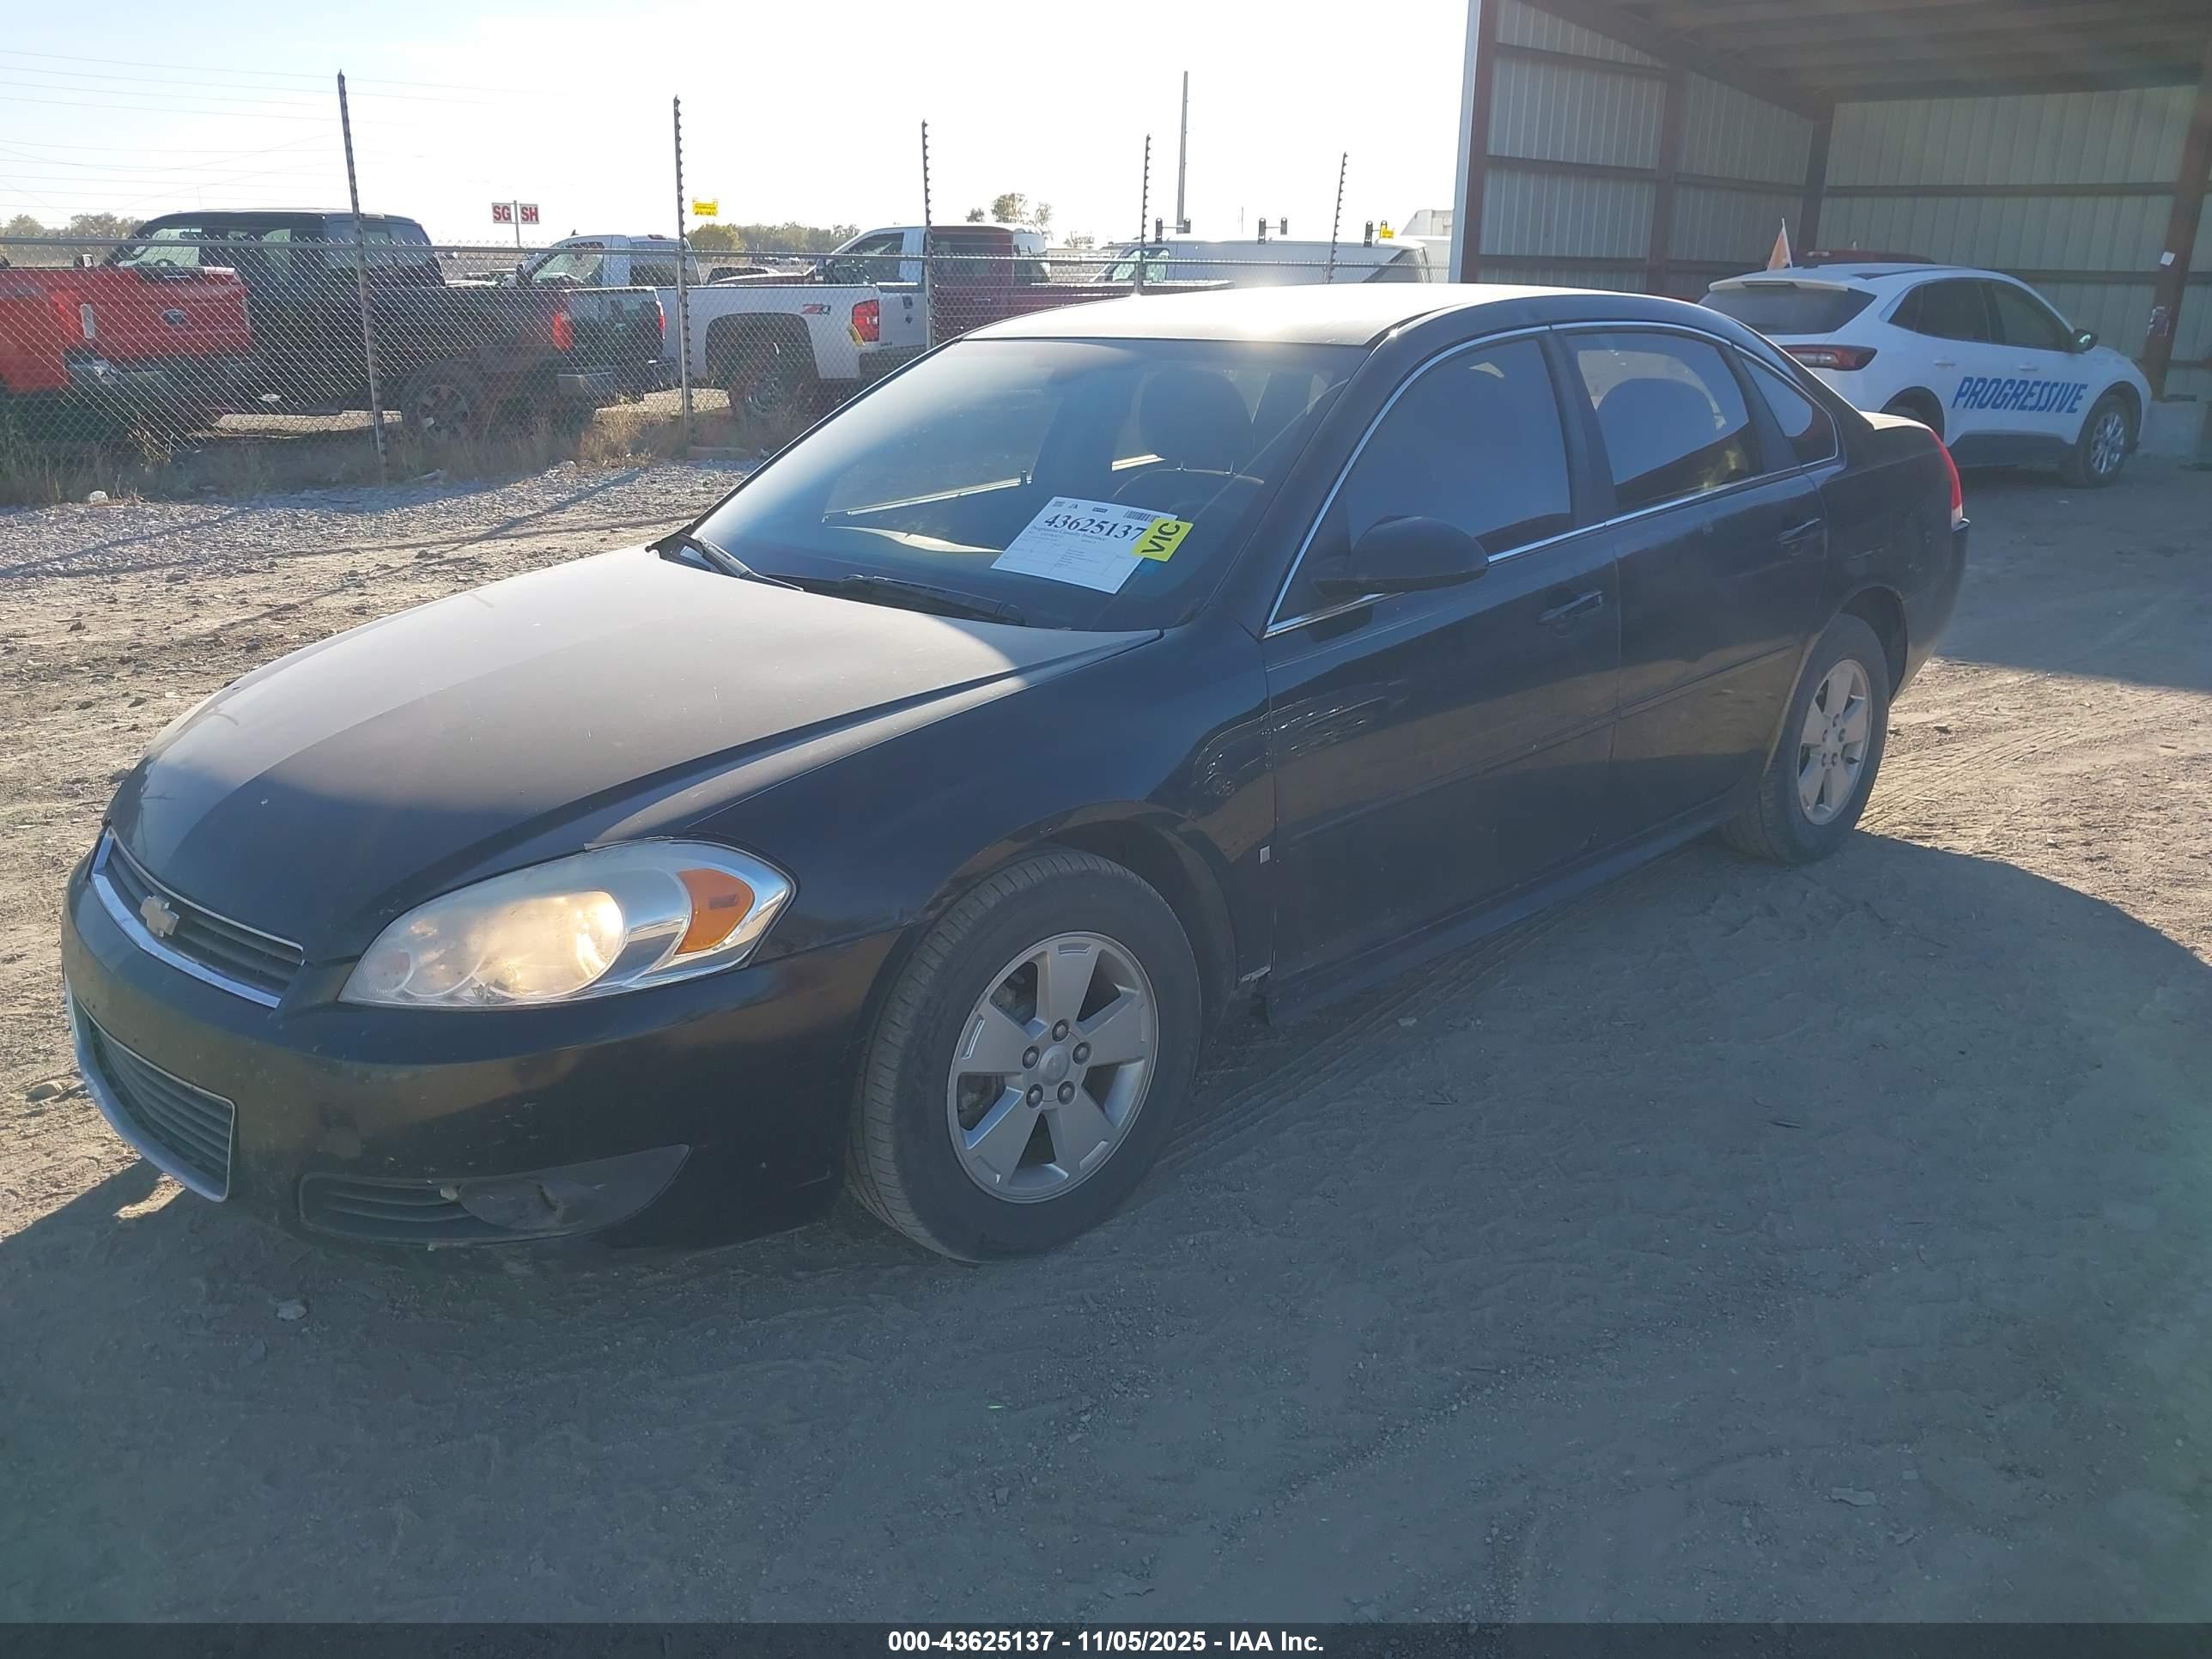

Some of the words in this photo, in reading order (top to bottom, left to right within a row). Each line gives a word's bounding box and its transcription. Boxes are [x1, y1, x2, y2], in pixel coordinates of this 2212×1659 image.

[493, 204, 511, 222] SG
[521, 205, 539, 222] SH
[1951, 377, 2088, 414] PROGRESSIVE
[1044, 514, 1147, 542] 43625137
[1141, 522, 1182, 556] VIC
